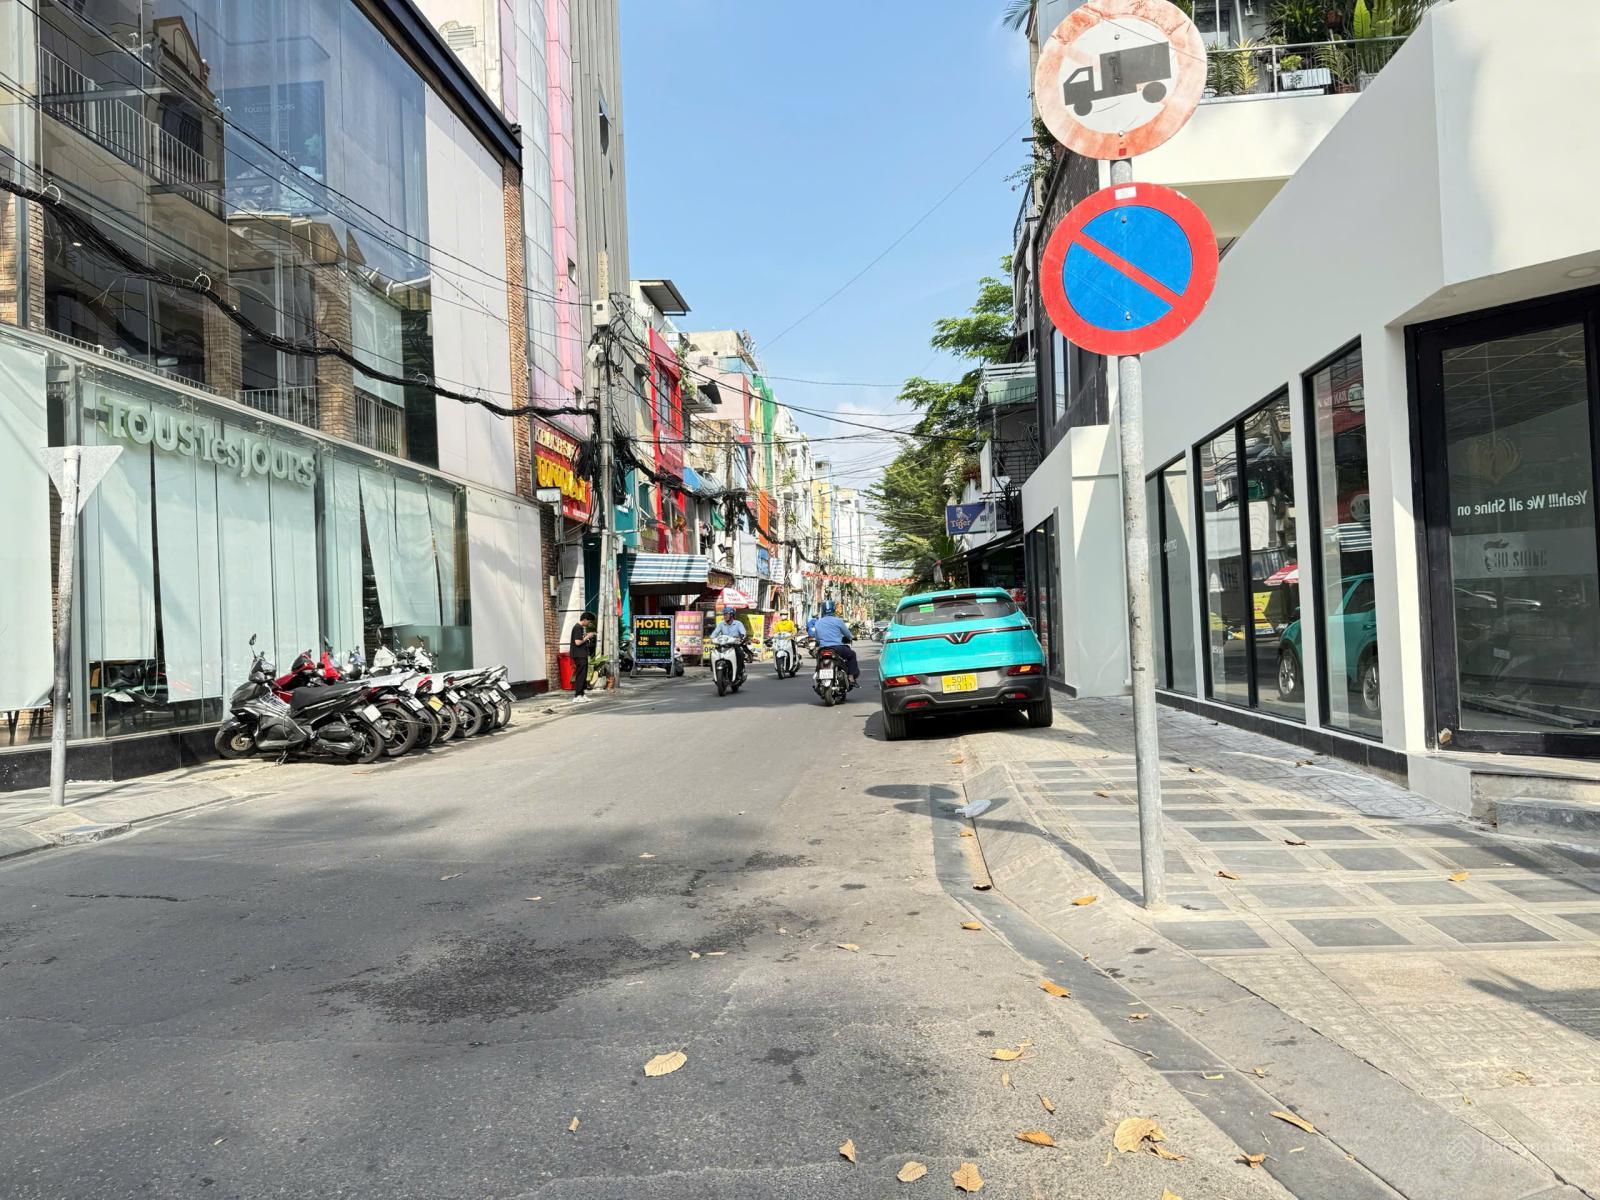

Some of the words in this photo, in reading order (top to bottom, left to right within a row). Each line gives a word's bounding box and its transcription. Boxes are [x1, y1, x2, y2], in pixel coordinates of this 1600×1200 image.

[102, 397, 196, 457] TOUS
[198, 423, 240, 468] les
[240, 438, 317, 488] JOURS
[950, 519, 971, 529] Tiger
[636, 619, 671, 629] HOTEL
[951, 674, 967, 684] 50H
